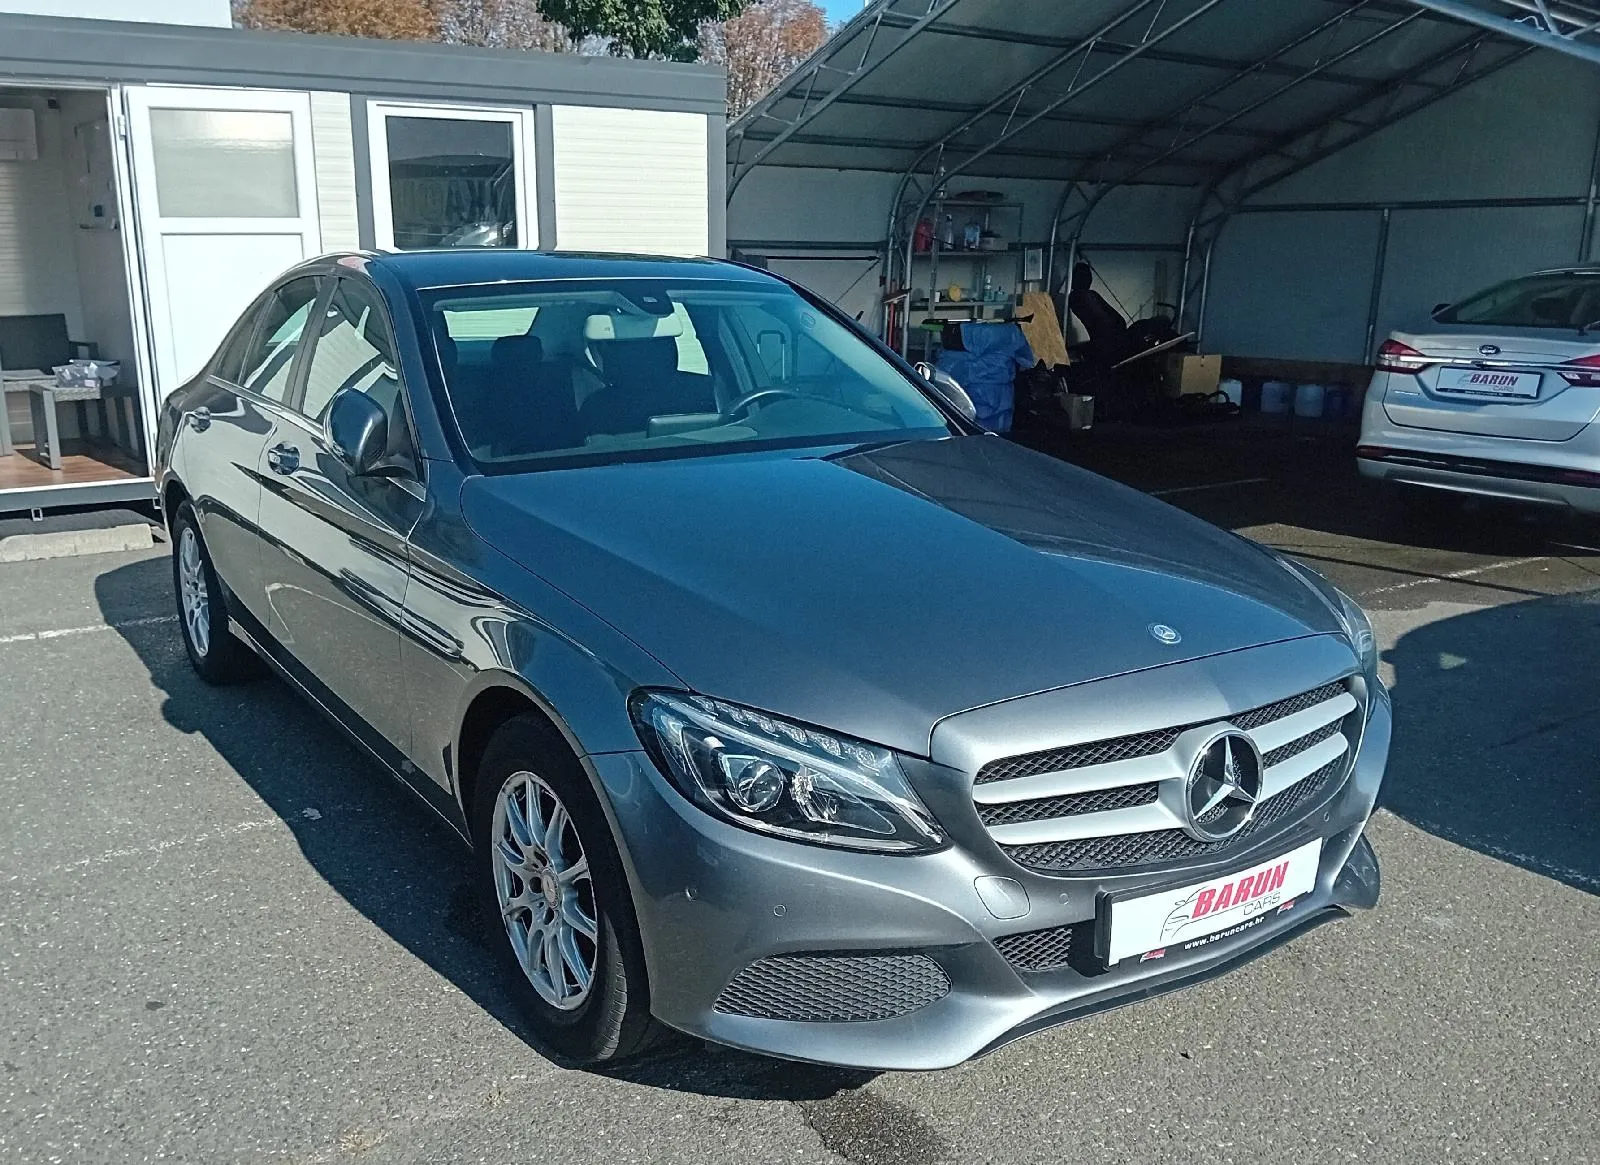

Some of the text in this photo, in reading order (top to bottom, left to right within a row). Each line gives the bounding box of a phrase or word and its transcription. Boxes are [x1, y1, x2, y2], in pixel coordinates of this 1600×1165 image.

[1470, 373, 1519, 386] BARUN
[1191, 861, 1289, 919] BARUN
[1243, 892, 1281, 916] CARS
[1184, 916, 1265, 950] www.baruncars.hr
